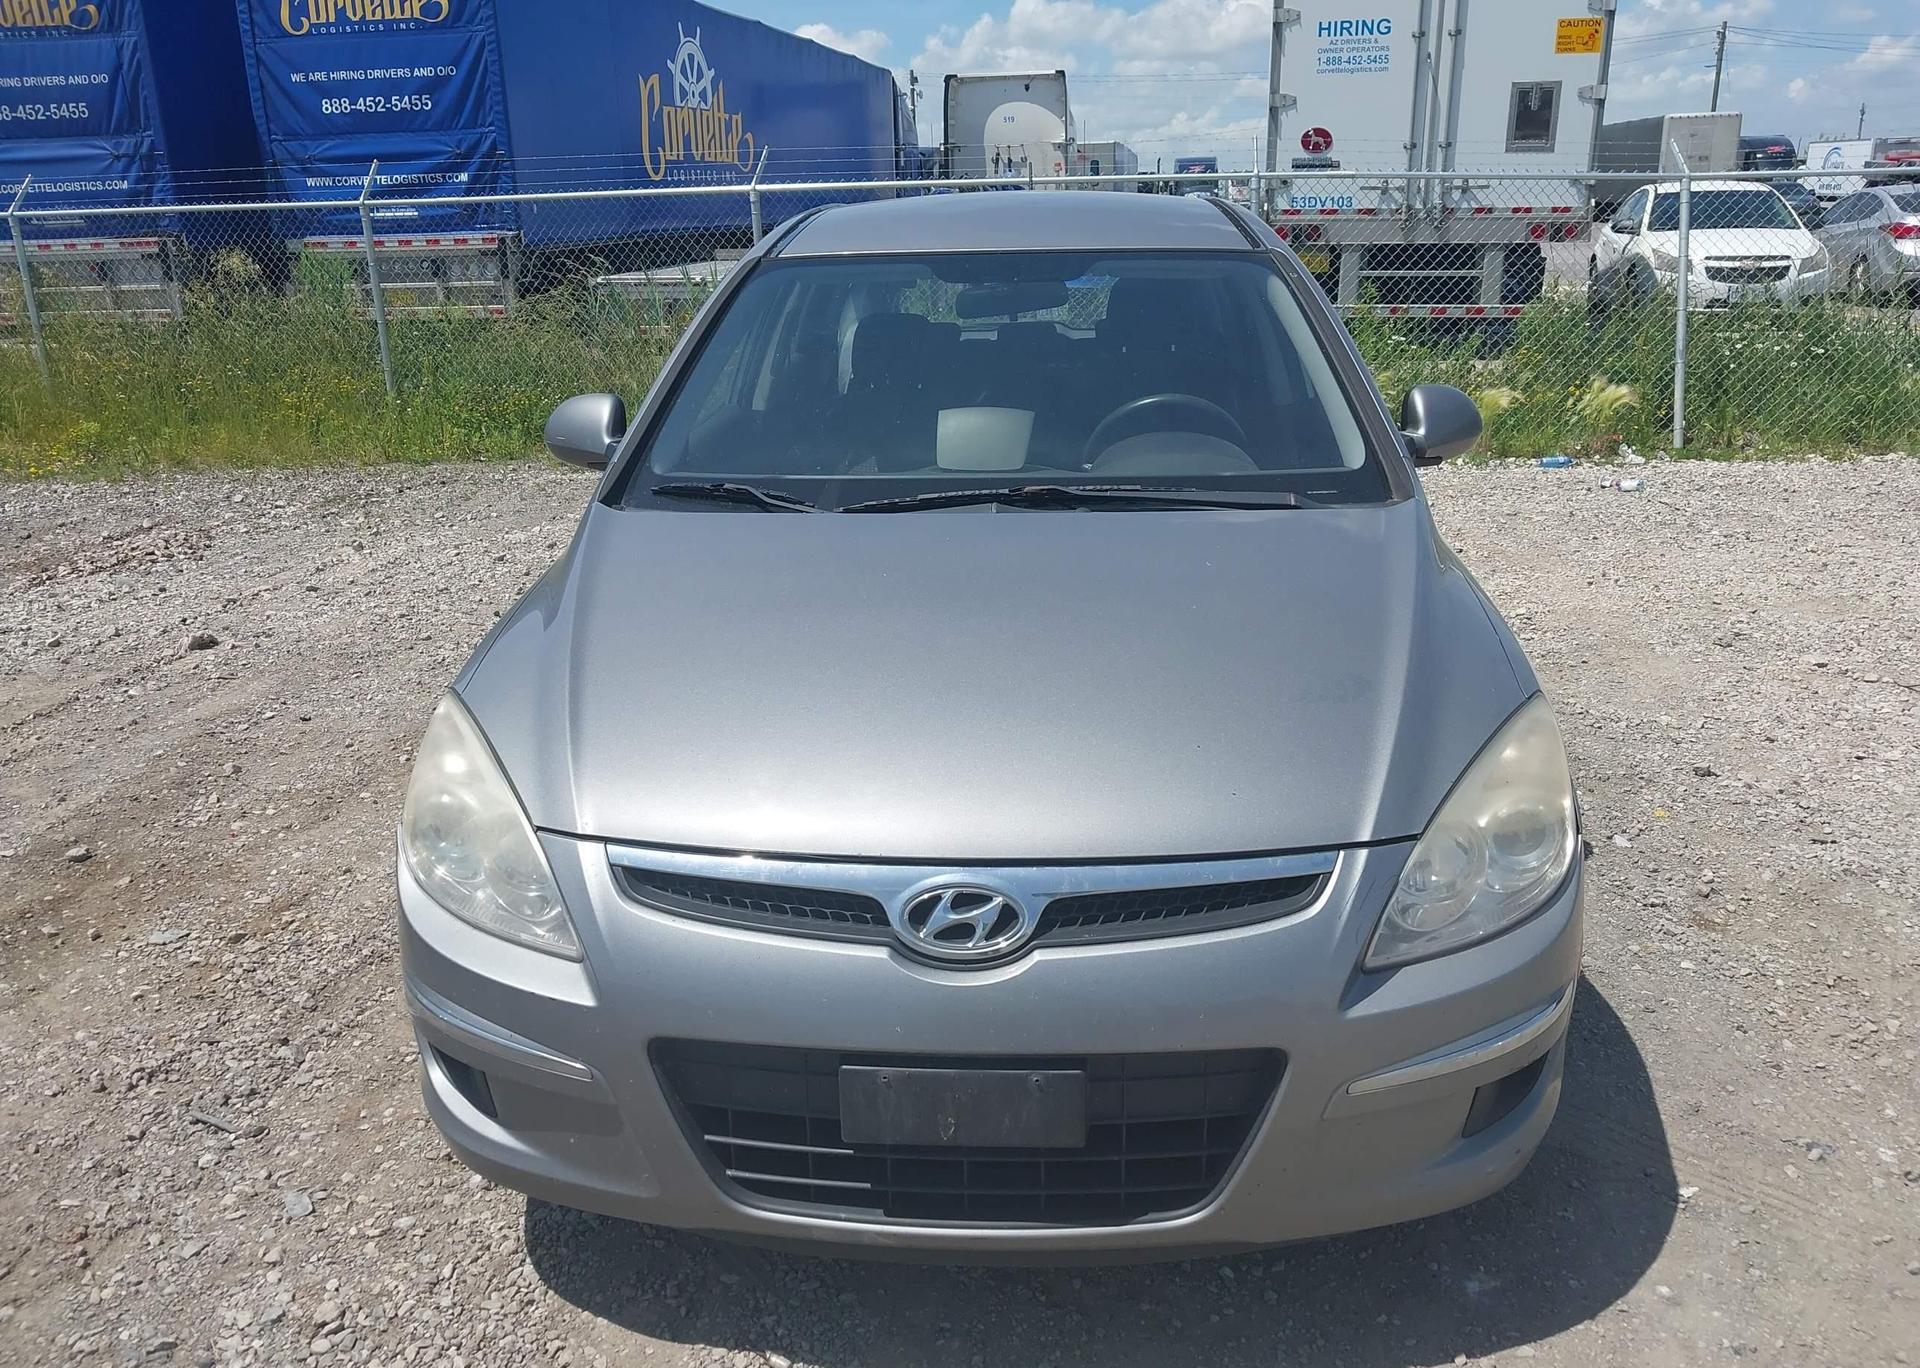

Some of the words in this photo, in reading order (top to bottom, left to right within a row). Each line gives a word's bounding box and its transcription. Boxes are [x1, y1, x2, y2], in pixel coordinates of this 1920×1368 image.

[312, 24, 384, 34] LOGISTICS
[393, 22, 423, 31] INC.
[1318, 18, 1392, 37] HIRING
[1560, 19, 1601, 28] CAUTION
[1340, 38, 1372, 46] DRIVERS
[1346, 45, 1390, 53] OPERATORS
[1317, 54, 1390, 66] 1-888-452-5455
[23, 75, 66, 87] DRIVERS
[68, 74, 89, 85] AND
[91, 73, 109, 84] O/O
[291, 73, 307, 82] WE
[308, 72, 328, 81] ARE
[330, 70, 366, 81] HIRING
[367, 68, 411, 79] DRIVERS
[413, 66, 434, 77] AND
[437, 65, 457, 76] O/O
[0, 102, 89, 121] 8-452-5455
[321, 95, 432, 114] 888-452-5455
[639, 73, 754, 181] Corvette
[306, 172, 468, 187] WWW.CORVETELOGISTICS.COM
[666, 169, 717, 182] LOGISTICS
[0, 180, 128, 194] .CORETTELOGISTICS.COM
[1291, 196, 1353, 208] 53DV103
